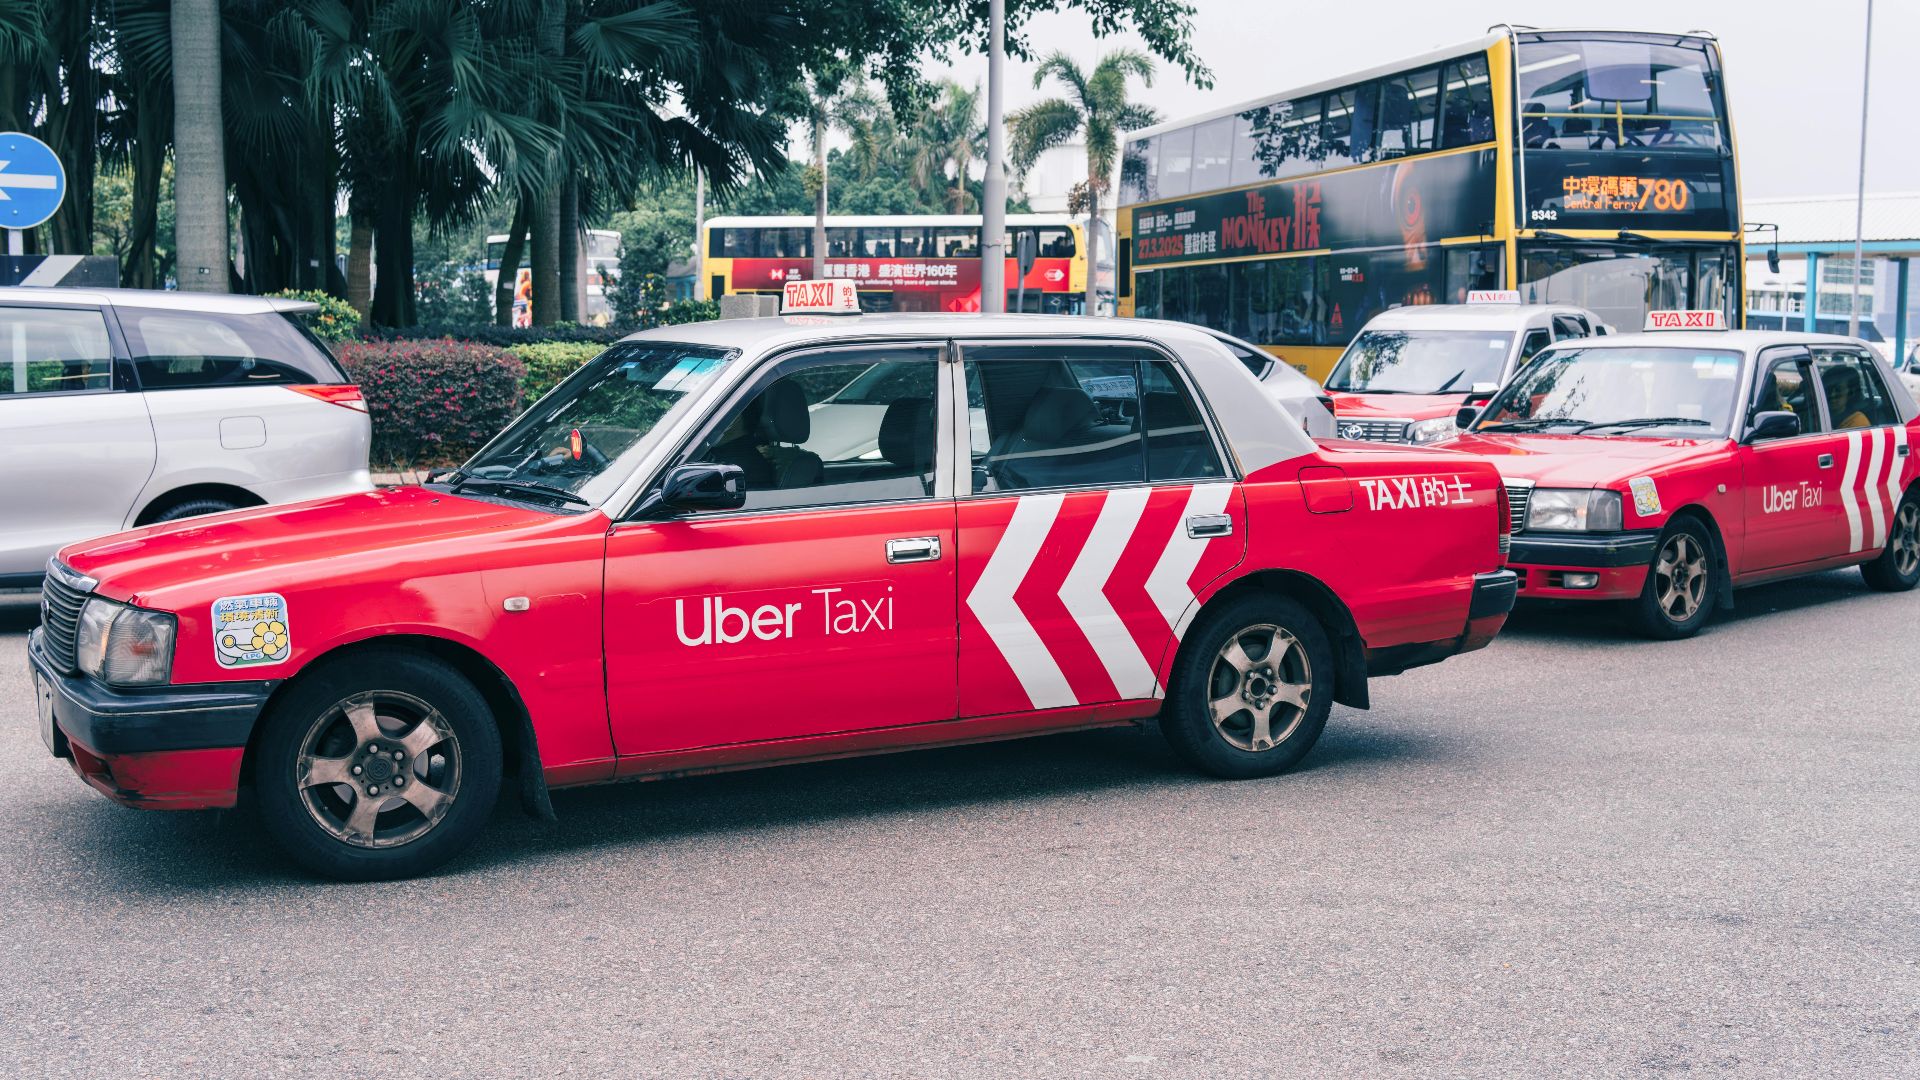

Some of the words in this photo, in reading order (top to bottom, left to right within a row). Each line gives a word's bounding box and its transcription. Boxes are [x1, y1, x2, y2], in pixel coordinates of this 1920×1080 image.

[1563, 175, 1638, 197] 中環碼頭
[1638, 178, 1687, 211] 780
[1605, 195, 1638, 212] Ferry
[1531, 209, 1557, 221] 8342
[1221, 214, 1291, 252] MONKEY
[1138, 234, 1184, 259] 27.3.2025
[786, 282, 834, 307] TAXI
[842, 286, 854, 309] 的士
[1651, 312, 1714, 327] TAXI
[1359, 478, 1420, 511] TAXI
[1421, 475, 1473, 507] 的士
[1763, 485, 1798, 514] Uber
[1799, 480, 1823, 508] Taxi
[675, 596, 801, 647] Uber
[812, 585, 893, 635] Taxi
